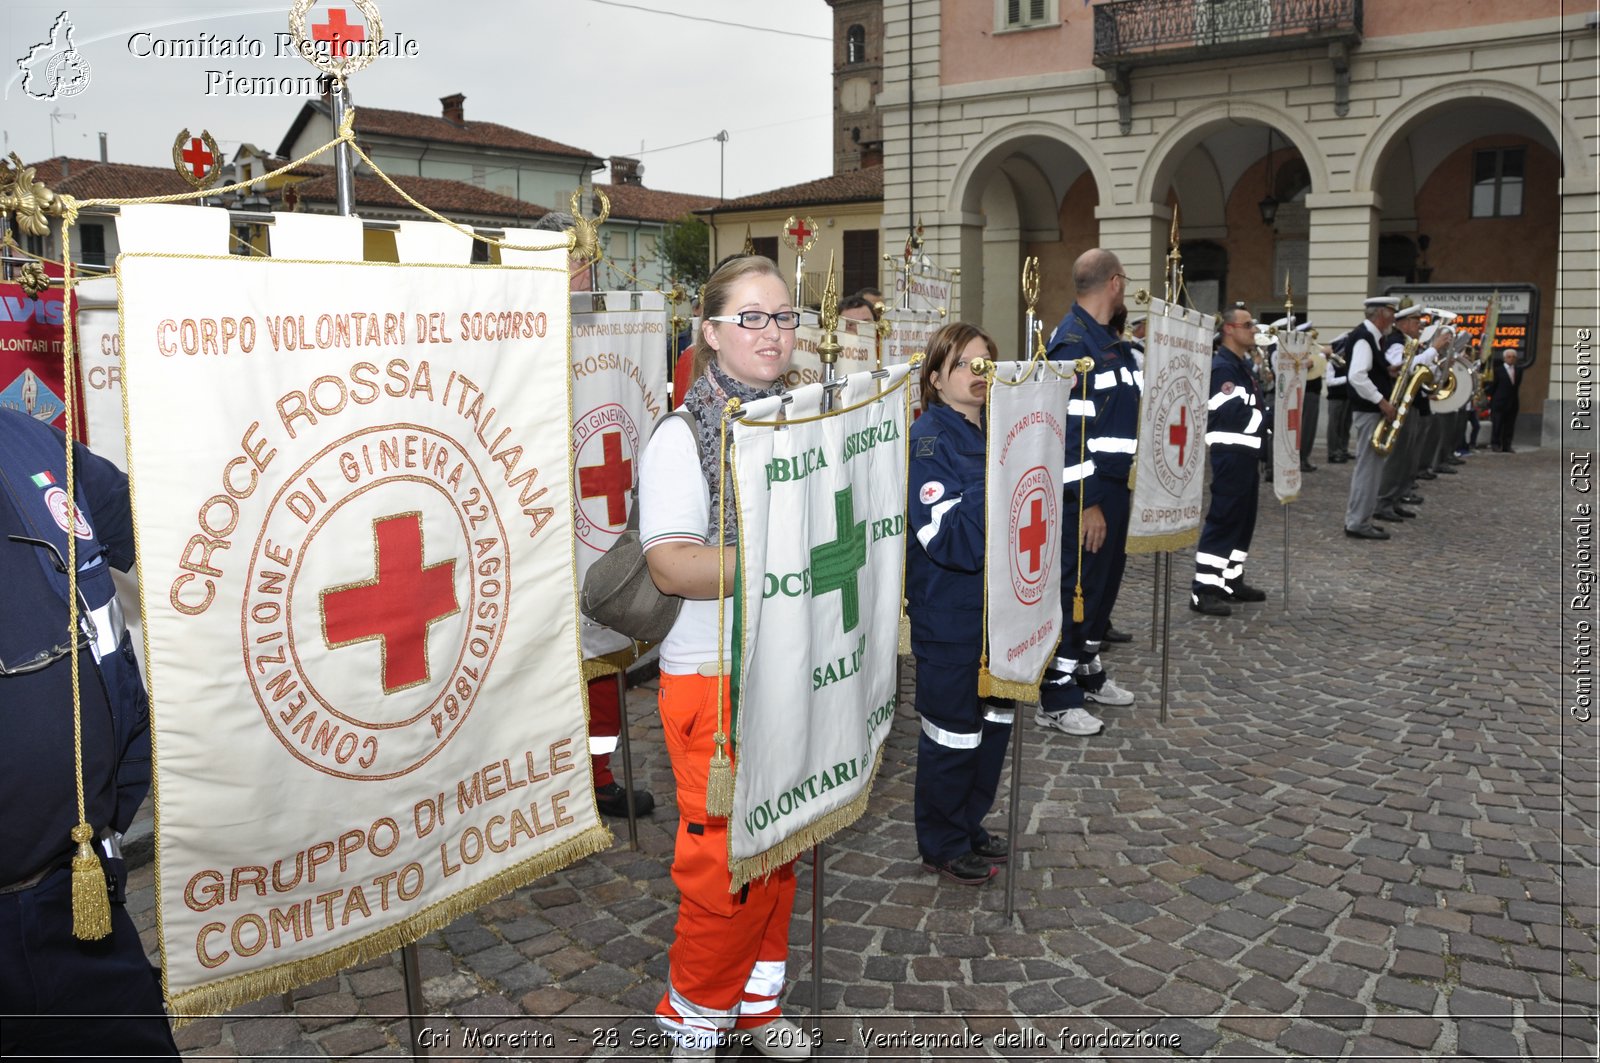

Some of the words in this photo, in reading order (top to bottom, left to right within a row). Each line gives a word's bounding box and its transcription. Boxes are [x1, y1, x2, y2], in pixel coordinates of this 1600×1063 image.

[1422, 294, 1462, 303] COMUNE
[1464, 294, 1475, 303] DI
[0, 338, 48, 353] LONTARI
[157, 317, 257, 357] CORPO
[267, 312, 406, 352] VOLONTARI
[416, 312, 453, 344] DEL
[461, 311, 548, 341] SOCCORSO
[572, 323, 609, 338] LONTARI
[1495, 327, 1526, 336] LEGGI
[572, 351, 622, 381] ROSSA
[576, 422, 590, 439] DI
[999, 415, 1031, 466] VOLONTARI
[1031, 411, 1045, 425] DEL
[169, 421, 277, 615] CROCE
[276, 358, 434, 439] ROSSA
[442, 370, 555, 538] ITALIANA
[338, 434, 464, 494] GINEVRA
[285, 478, 327, 524] DI
[461, 487, 490, 530] 22
[763, 567, 811, 599] OCE
[872, 513, 904, 544] ERD
[468, 537, 500, 659] AGOSTO
[252, 539, 379, 769] CONVENZIONE
[1007, 638, 1029, 662] Gruppo
[429, 664, 480, 739] 1864
[745, 757, 859, 839] VOLONTARI
[183, 817, 401, 913] GRUPPO
[414, 792, 446, 839] DI
[457, 738, 575, 815] MELLE
[195, 861, 425, 970] COMITATO
[440, 790, 574, 878] LOCALE
